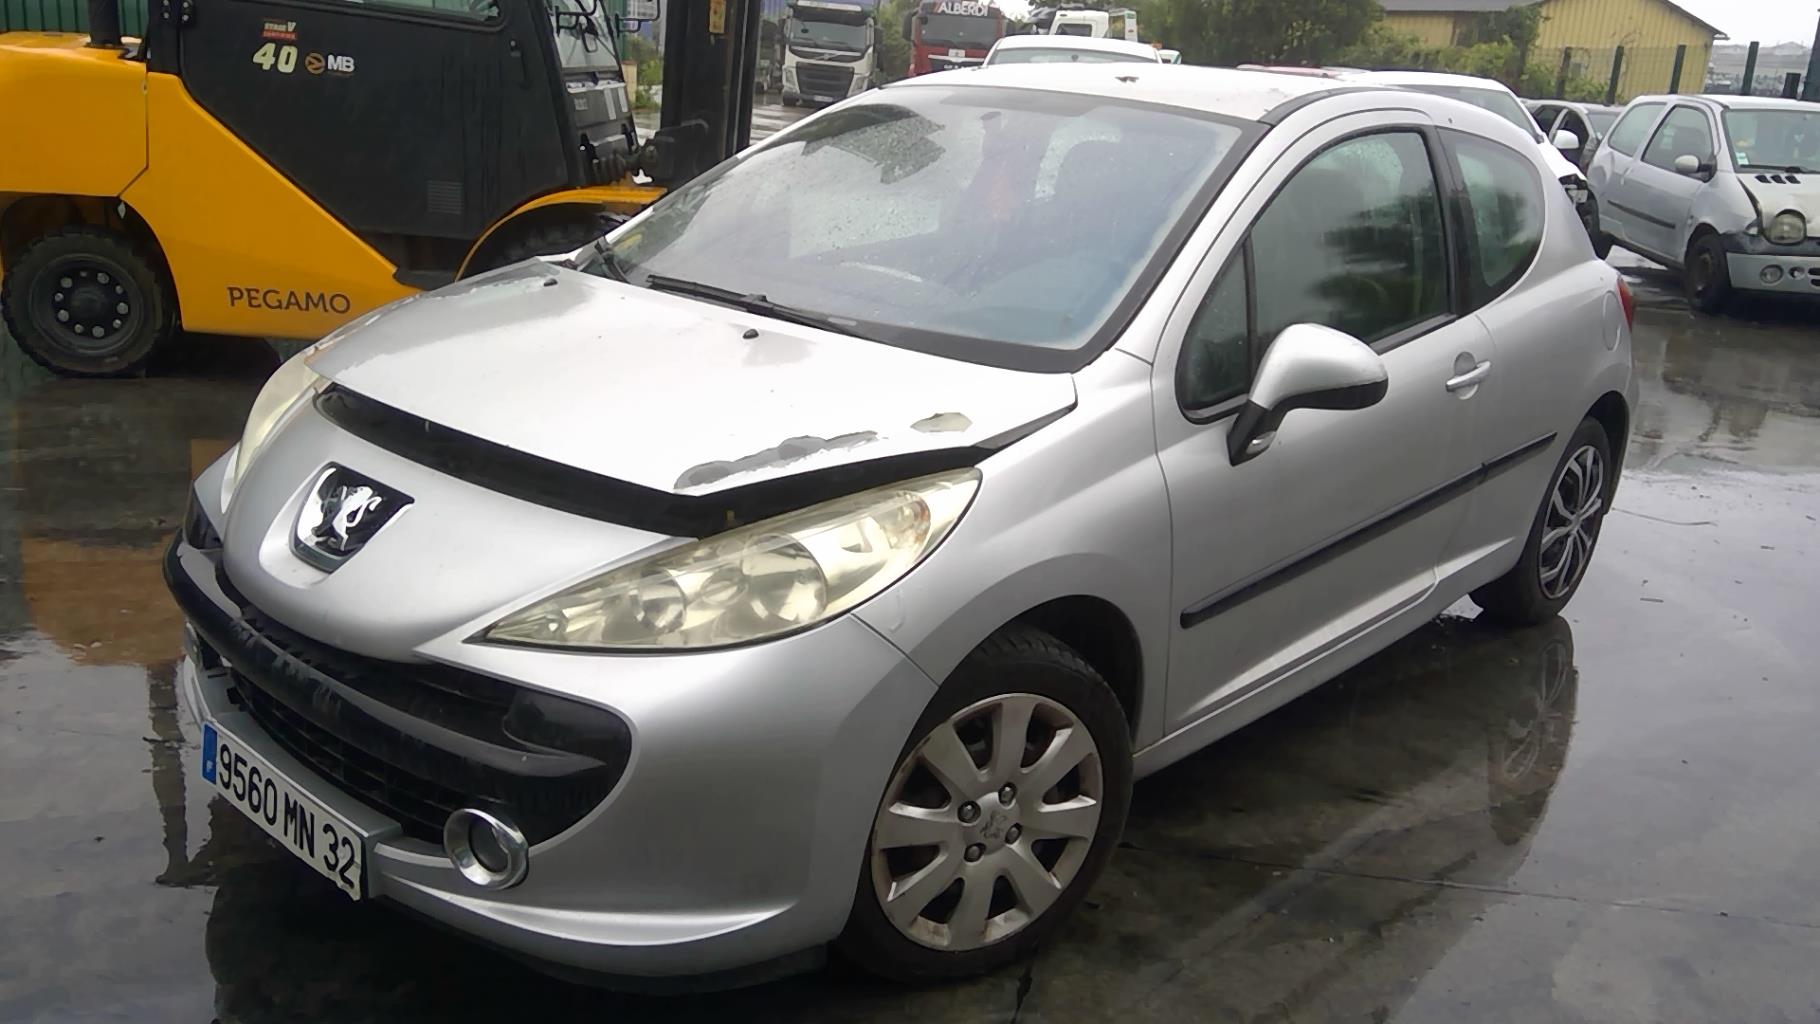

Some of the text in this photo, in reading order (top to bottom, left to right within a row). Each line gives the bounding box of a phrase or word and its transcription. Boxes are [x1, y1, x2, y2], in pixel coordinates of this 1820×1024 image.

[938, 0, 989, 16] ALBERDI
[253, 42, 298, 73] 40
[327, 54, 355, 72] MB
[227, 286, 351, 314] PEGAMO
[218, 743, 356, 889] 9560 MN 32
